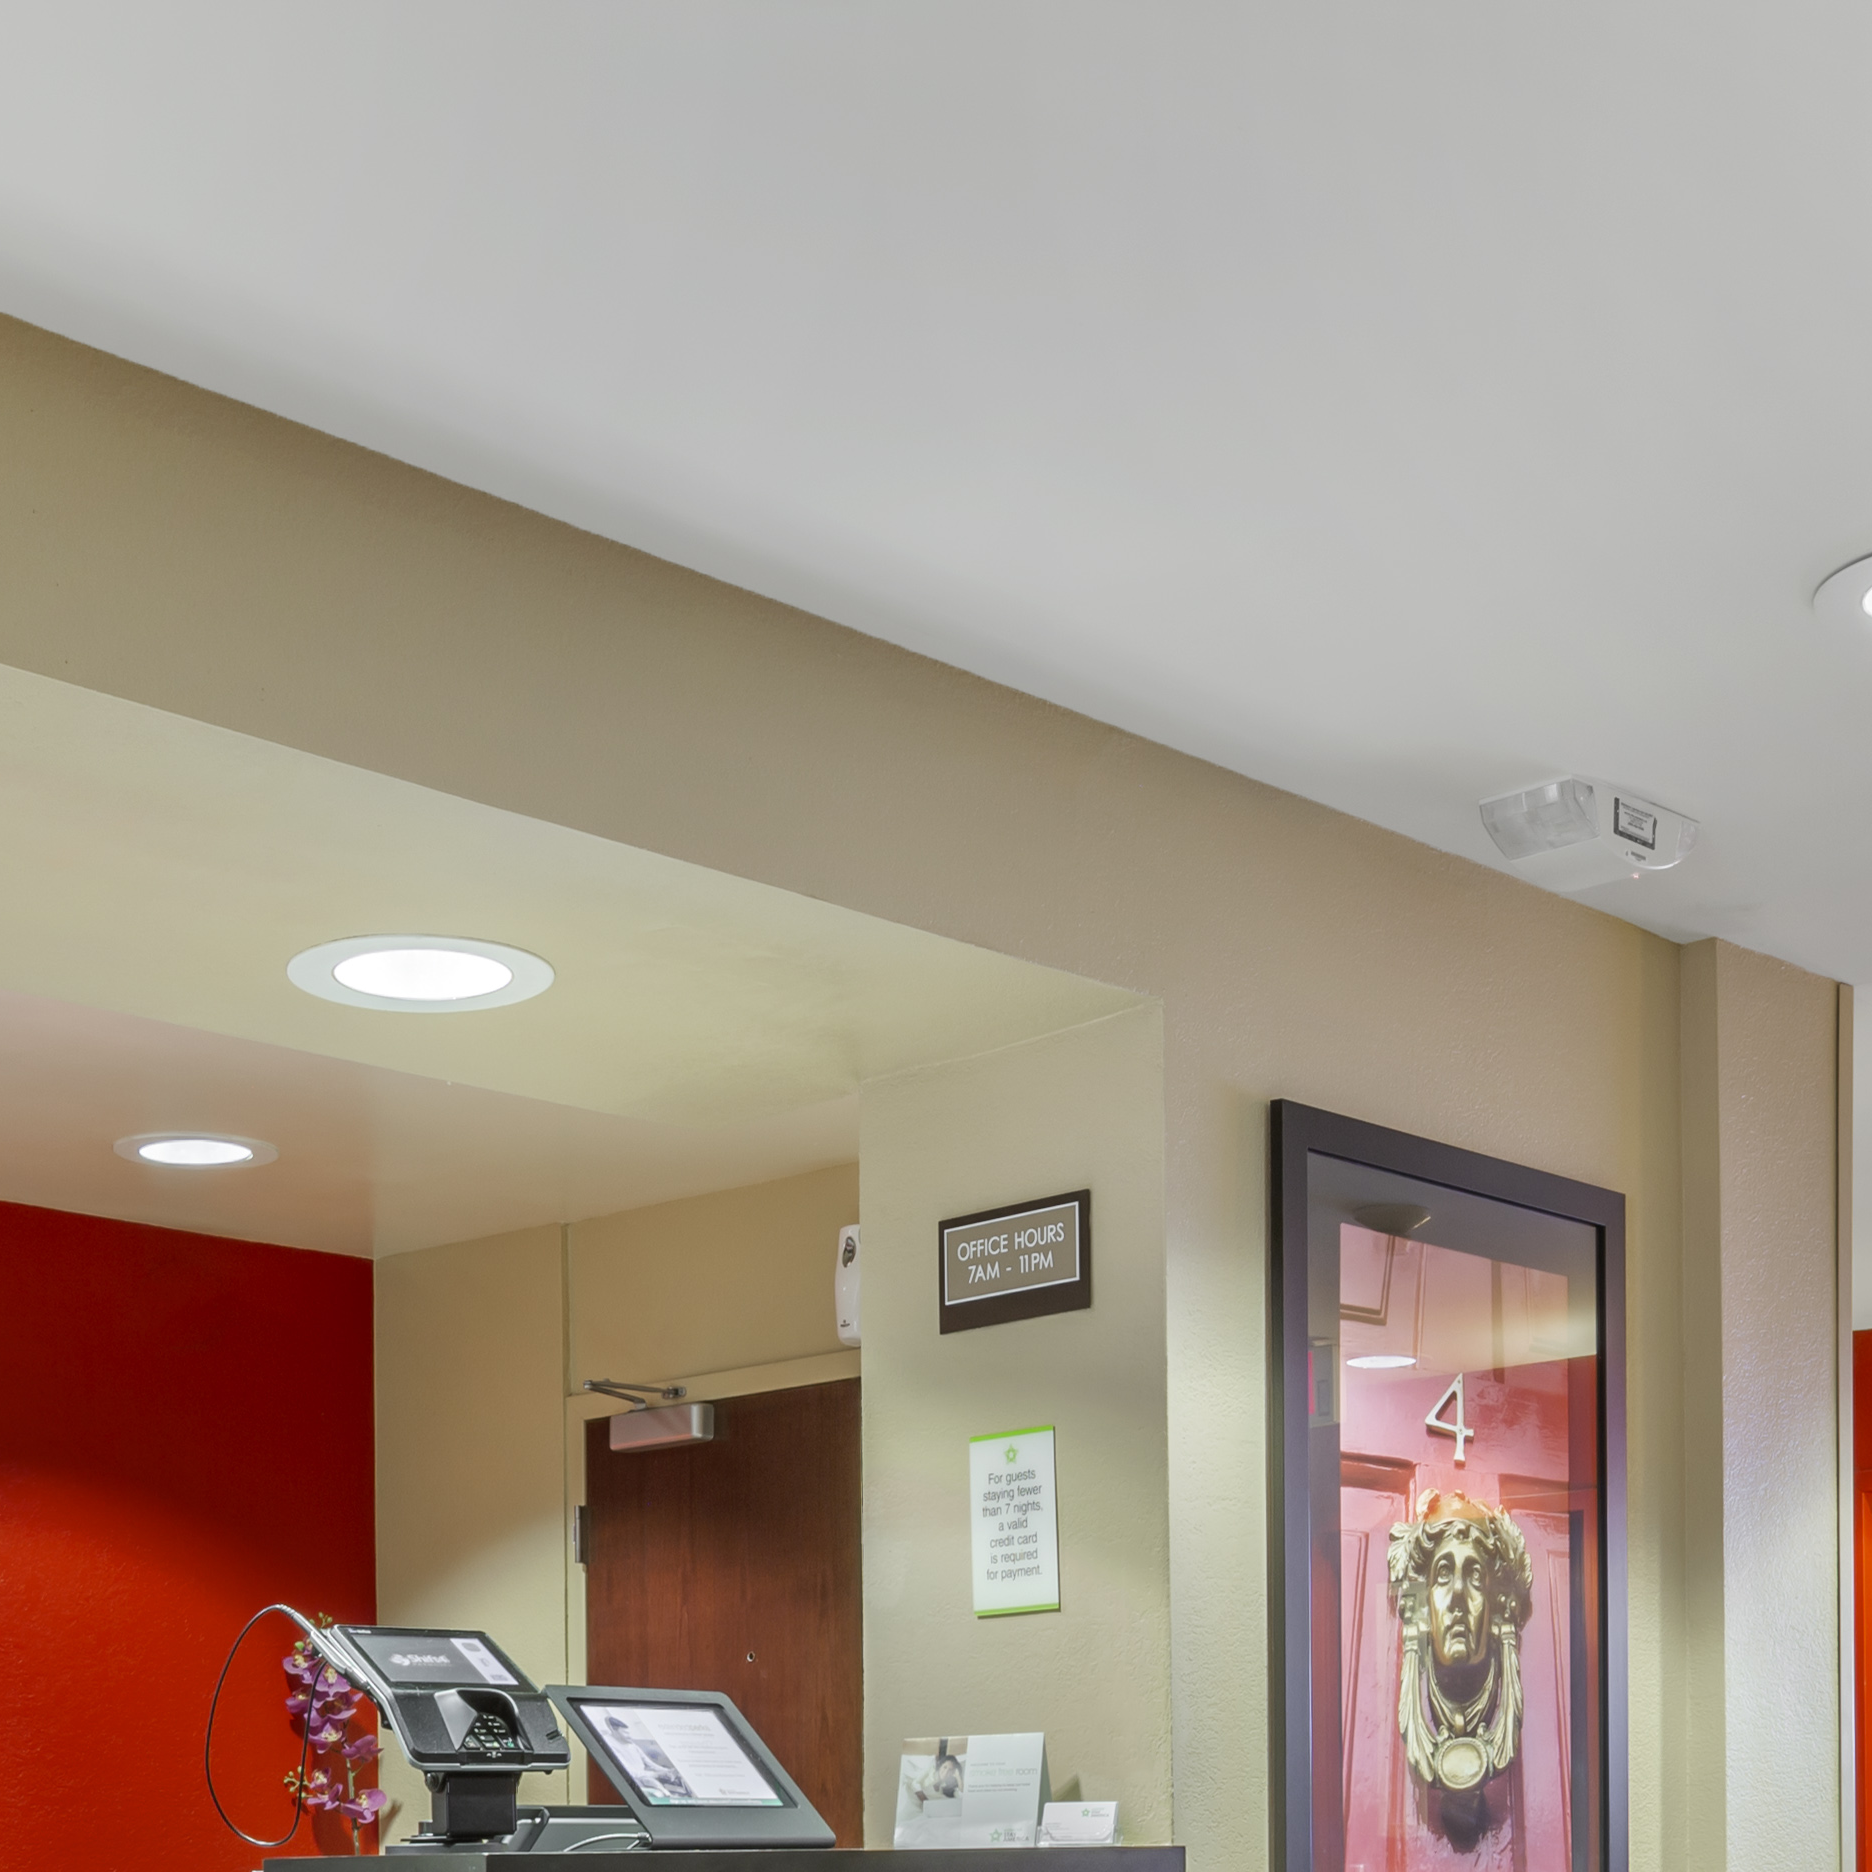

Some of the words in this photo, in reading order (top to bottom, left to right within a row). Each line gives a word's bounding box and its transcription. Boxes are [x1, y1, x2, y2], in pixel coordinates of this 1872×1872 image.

[957, 1234, 1008, 1261] OFFICE
[1014, 1222, 1065, 1250] HOURS
[968, 1261, 1000, 1284] 7AM
[1019, 1250, 1054, 1274] 11PM
[1424, 1372, 1475, 1461] 4
[987, 1473, 1003, 1485] For
[1005, 1469, 1036, 1486] guests
[982, 1489, 1015, 1503] staying
[1017, 1484, 1042, 1497] fewer
[982, 1506, 1002, 1518] than
[1005, 1503, 1011, 1514] 7
[998, 1522, 1004, 1531] a
[1006, 1517, 1028, 1531] valid
[989, 1534, 1015, 1549] credit
[1017, 1532, 1038, 1546] card
[990, 1552, 998, 1564] is
[1000, 1548, 1038, 1564] required
[986, 1568, 998, 1580] for
[1001, 1565, 1043, 1582] payment.
[1015, 1767, 1038, 1776] room
